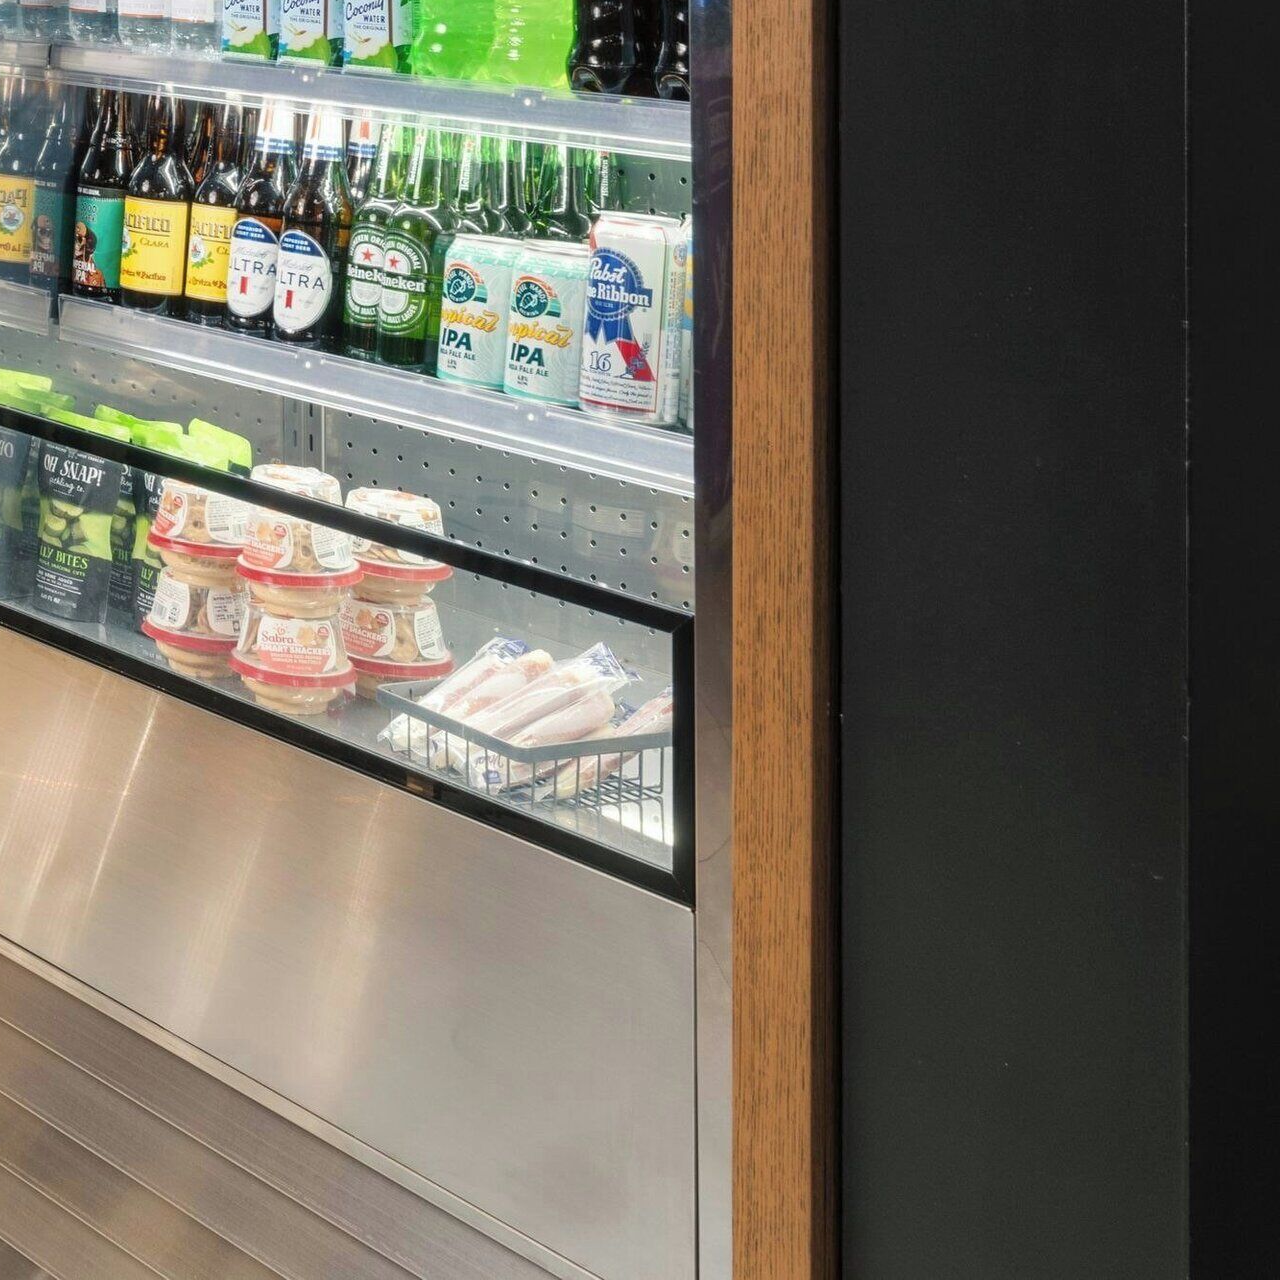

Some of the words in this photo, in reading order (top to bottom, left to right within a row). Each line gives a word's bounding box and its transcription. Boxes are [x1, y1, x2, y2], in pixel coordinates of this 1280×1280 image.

[240, 4, 260, 13] WATER
[300, 8, 321, 16] WATER
[363, 15, 386, 23] WATER
[140, 237, 169, 249] CLARA
[295, 243, 311, 252] BEER
[396, 241, 422, 269] ORIGINAL
[229, 259, 276, 277] LTRA
[590, 257, 627, 283] Pabst
[458, 270, 475, 289] HANDS
[529, 283, 547, 303] HANDS
[597, 283, 650, 307] Ribbon
[442, 327, 472, 351] IPA
[448, 350, 462, 359] PALE
[463, 352, 476, 361] ALE
[510, 342, 545, 367] IPA
[590, 351, 611, 372] 16
[519, 365, 534, 374] PALE
[535, 367, 549, 377] ALE
[44, 453, 57, 472] OH
[60, 459, 103, 487] SNAP!
[56, 551, 89, 570] BITES
[261, 631, 294, 644] Sabra
[289, 646, 331, 656] SNACKERS
